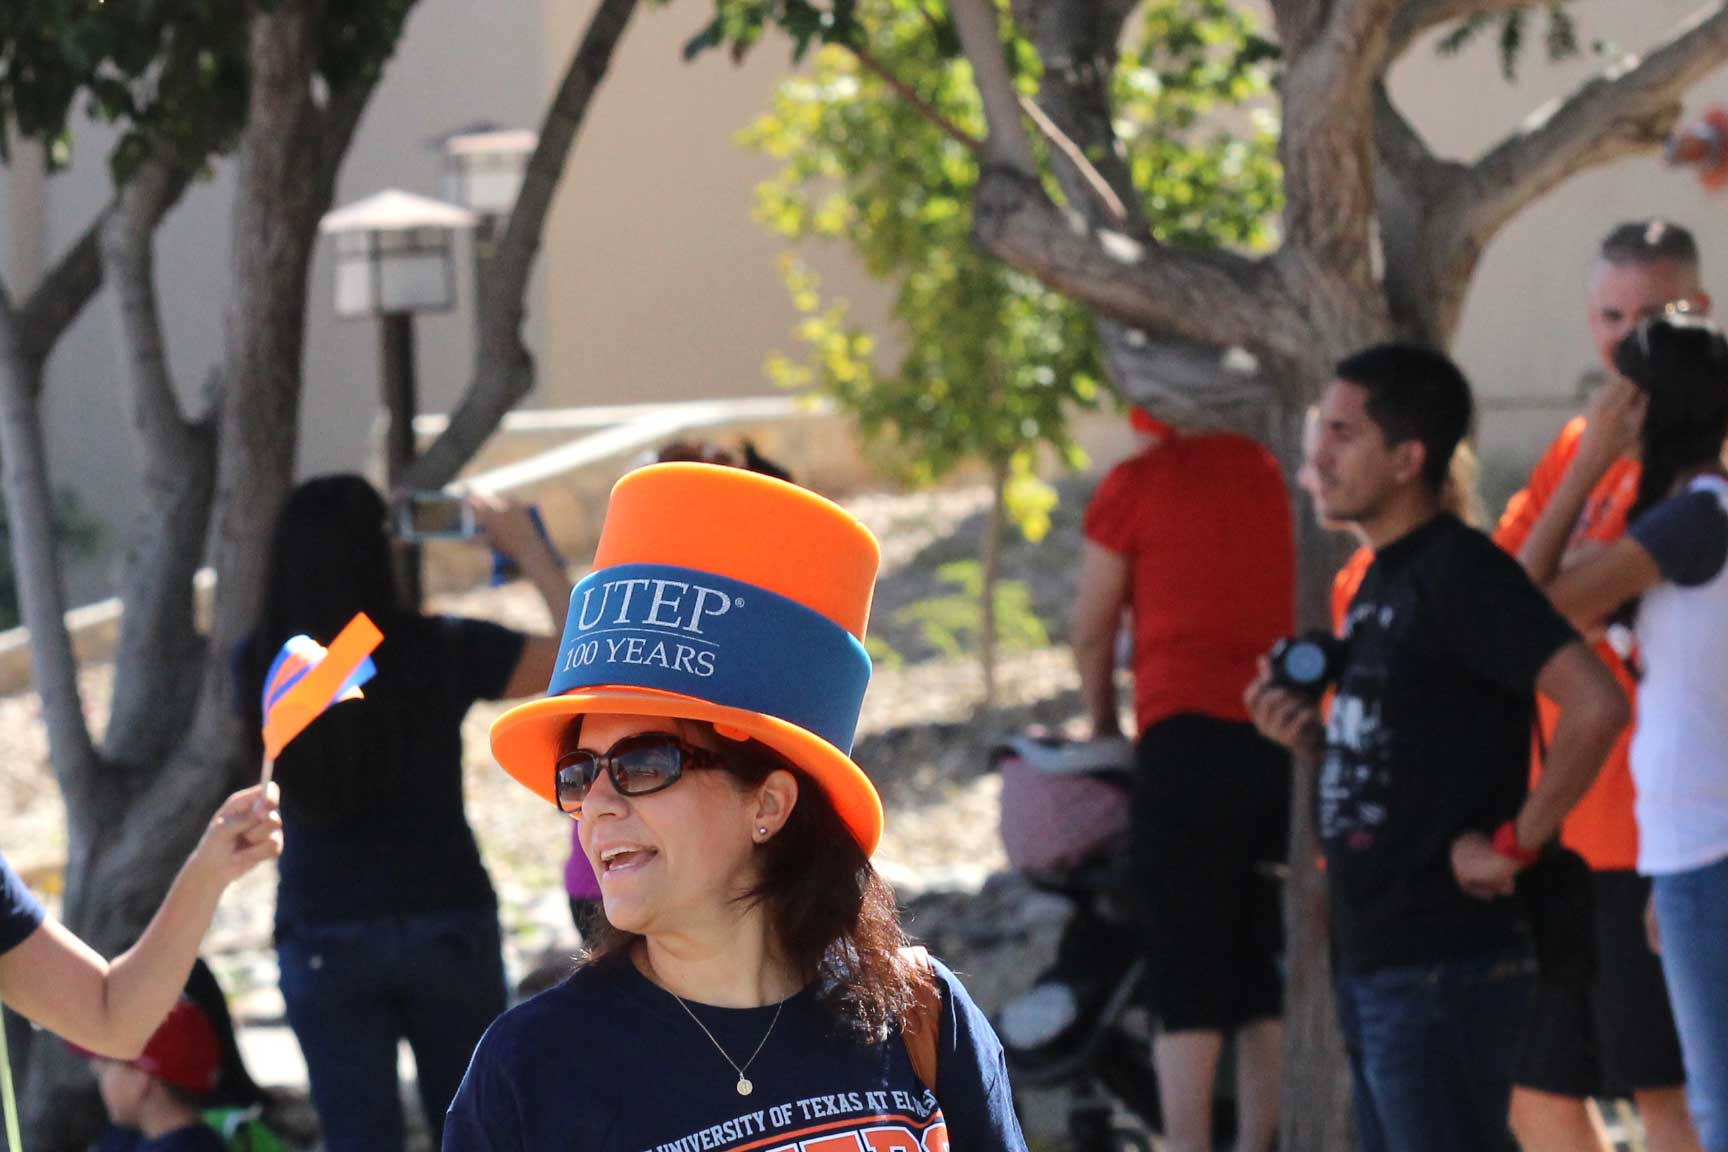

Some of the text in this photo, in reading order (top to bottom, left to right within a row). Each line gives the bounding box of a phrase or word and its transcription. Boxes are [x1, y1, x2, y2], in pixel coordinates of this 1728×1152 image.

[563, 638, 717, 677] 100 YEARS
[769, 1103, 793, 1128] OF
[796, 1092, 864, 1120] TEXAS
[865, 1091, 889, 1110] AT
[891, 1091, 915, 1112] EL
